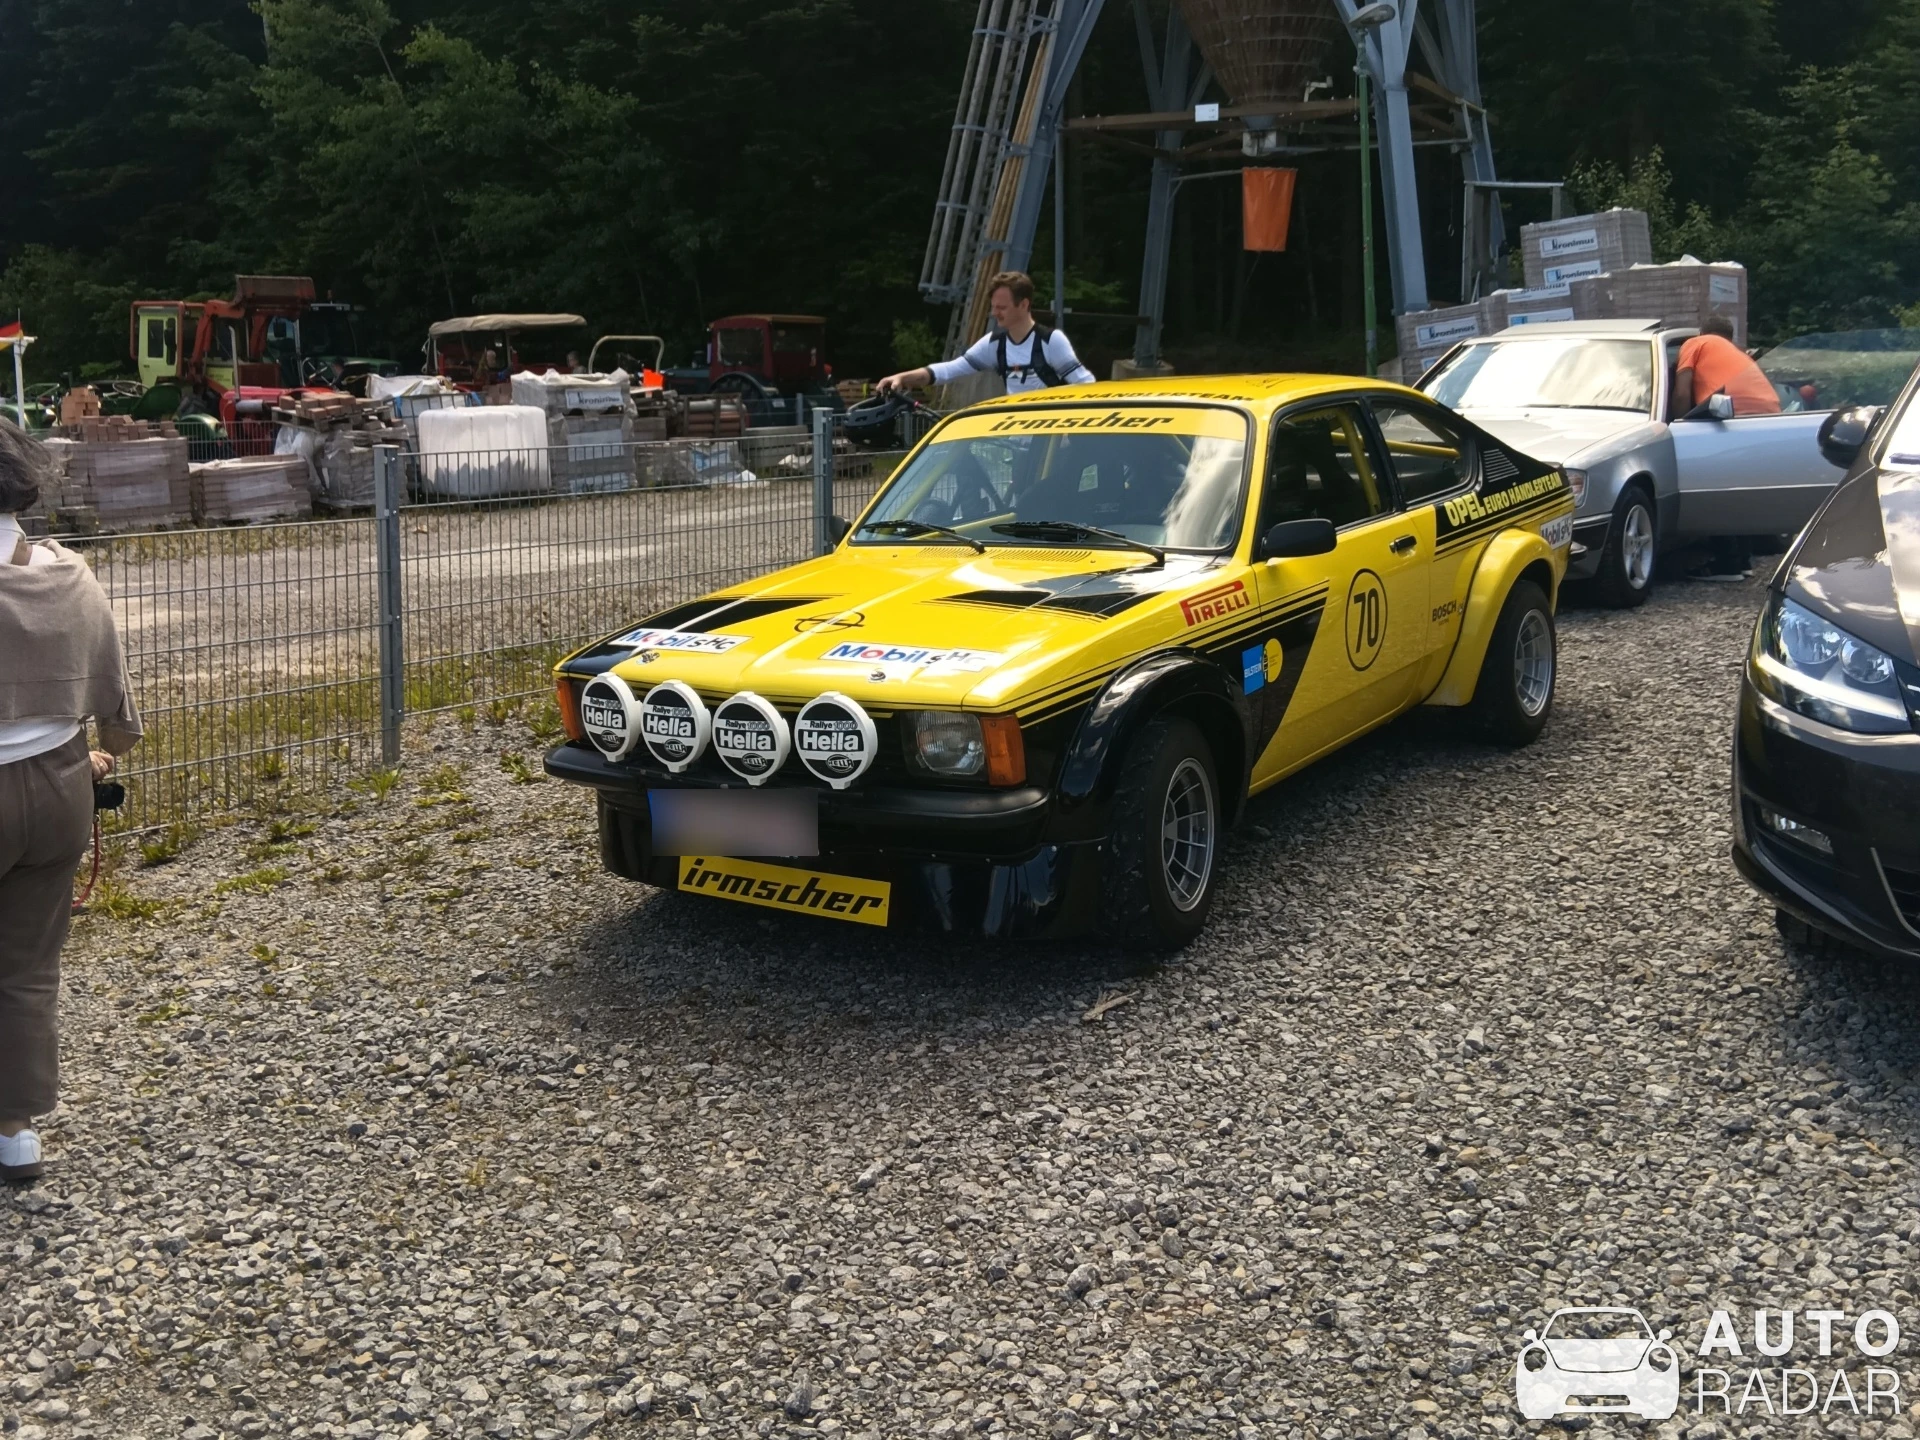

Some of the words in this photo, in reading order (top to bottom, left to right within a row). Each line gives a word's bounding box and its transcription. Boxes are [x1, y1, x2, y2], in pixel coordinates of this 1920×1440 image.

[1552, 238, 1594, 250] kronimus
[1556, 270, 1598, 281] kronimus
[1429, 326, 1475, 339] kronimus
[989, 411, 1174, 432] irmscher
[1444, 491, 1487, 527] OPEL
[1483, 490, 1511, 514] EURO
[1179, 580, 1250, 627] PIRELLI
[1432, 600, 1457, 622] BOSCH
[1354, 588, 1379, 653] 70
[621, 631, 696, 646] Mobil
[829, 644, 928, 663] Mobil
[585, 706, 623, 728] Hella
[653, 705, 671, 715] Rallye
[646, 714, 692, 737] Hella
[725, 719, 746, 729] Rallye
[810, 720, 832, 730] Rallye
[665, 741, 688, 753] HELLA
[719, 729, 771, 750] Hella
[803, 730, 859, 751] Hella
[743, 756, 767, 767] HELLA
[827, 758, 853, 769] HELLA
[682, 858, 883, 914] irmscher
